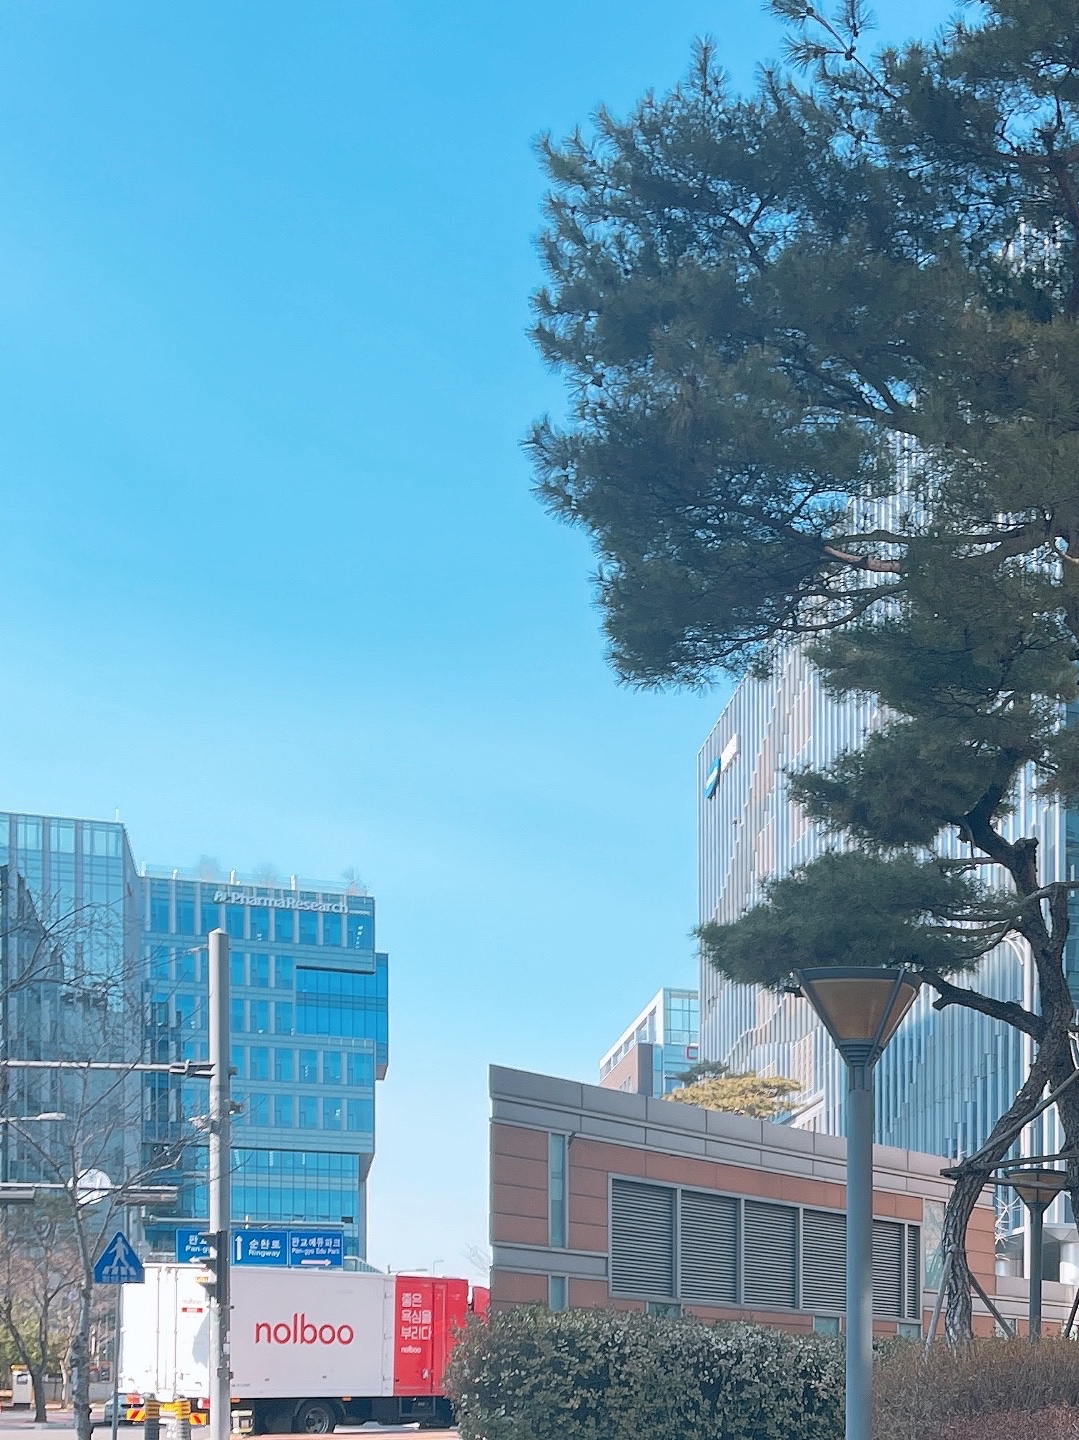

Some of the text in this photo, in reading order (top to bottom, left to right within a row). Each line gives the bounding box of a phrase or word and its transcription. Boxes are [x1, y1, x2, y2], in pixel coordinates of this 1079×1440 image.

[231, 890, 349, 914] PharmaResearch
[401, 1292, 422, 1308] 좋은
[401, 1309, 432, 1325] 욕심을
[255, 1312, 354, 1345] nolboo
[400, 1326, 432, 1341] 부리다
[400, 1345, 421, 1354] nolboo
